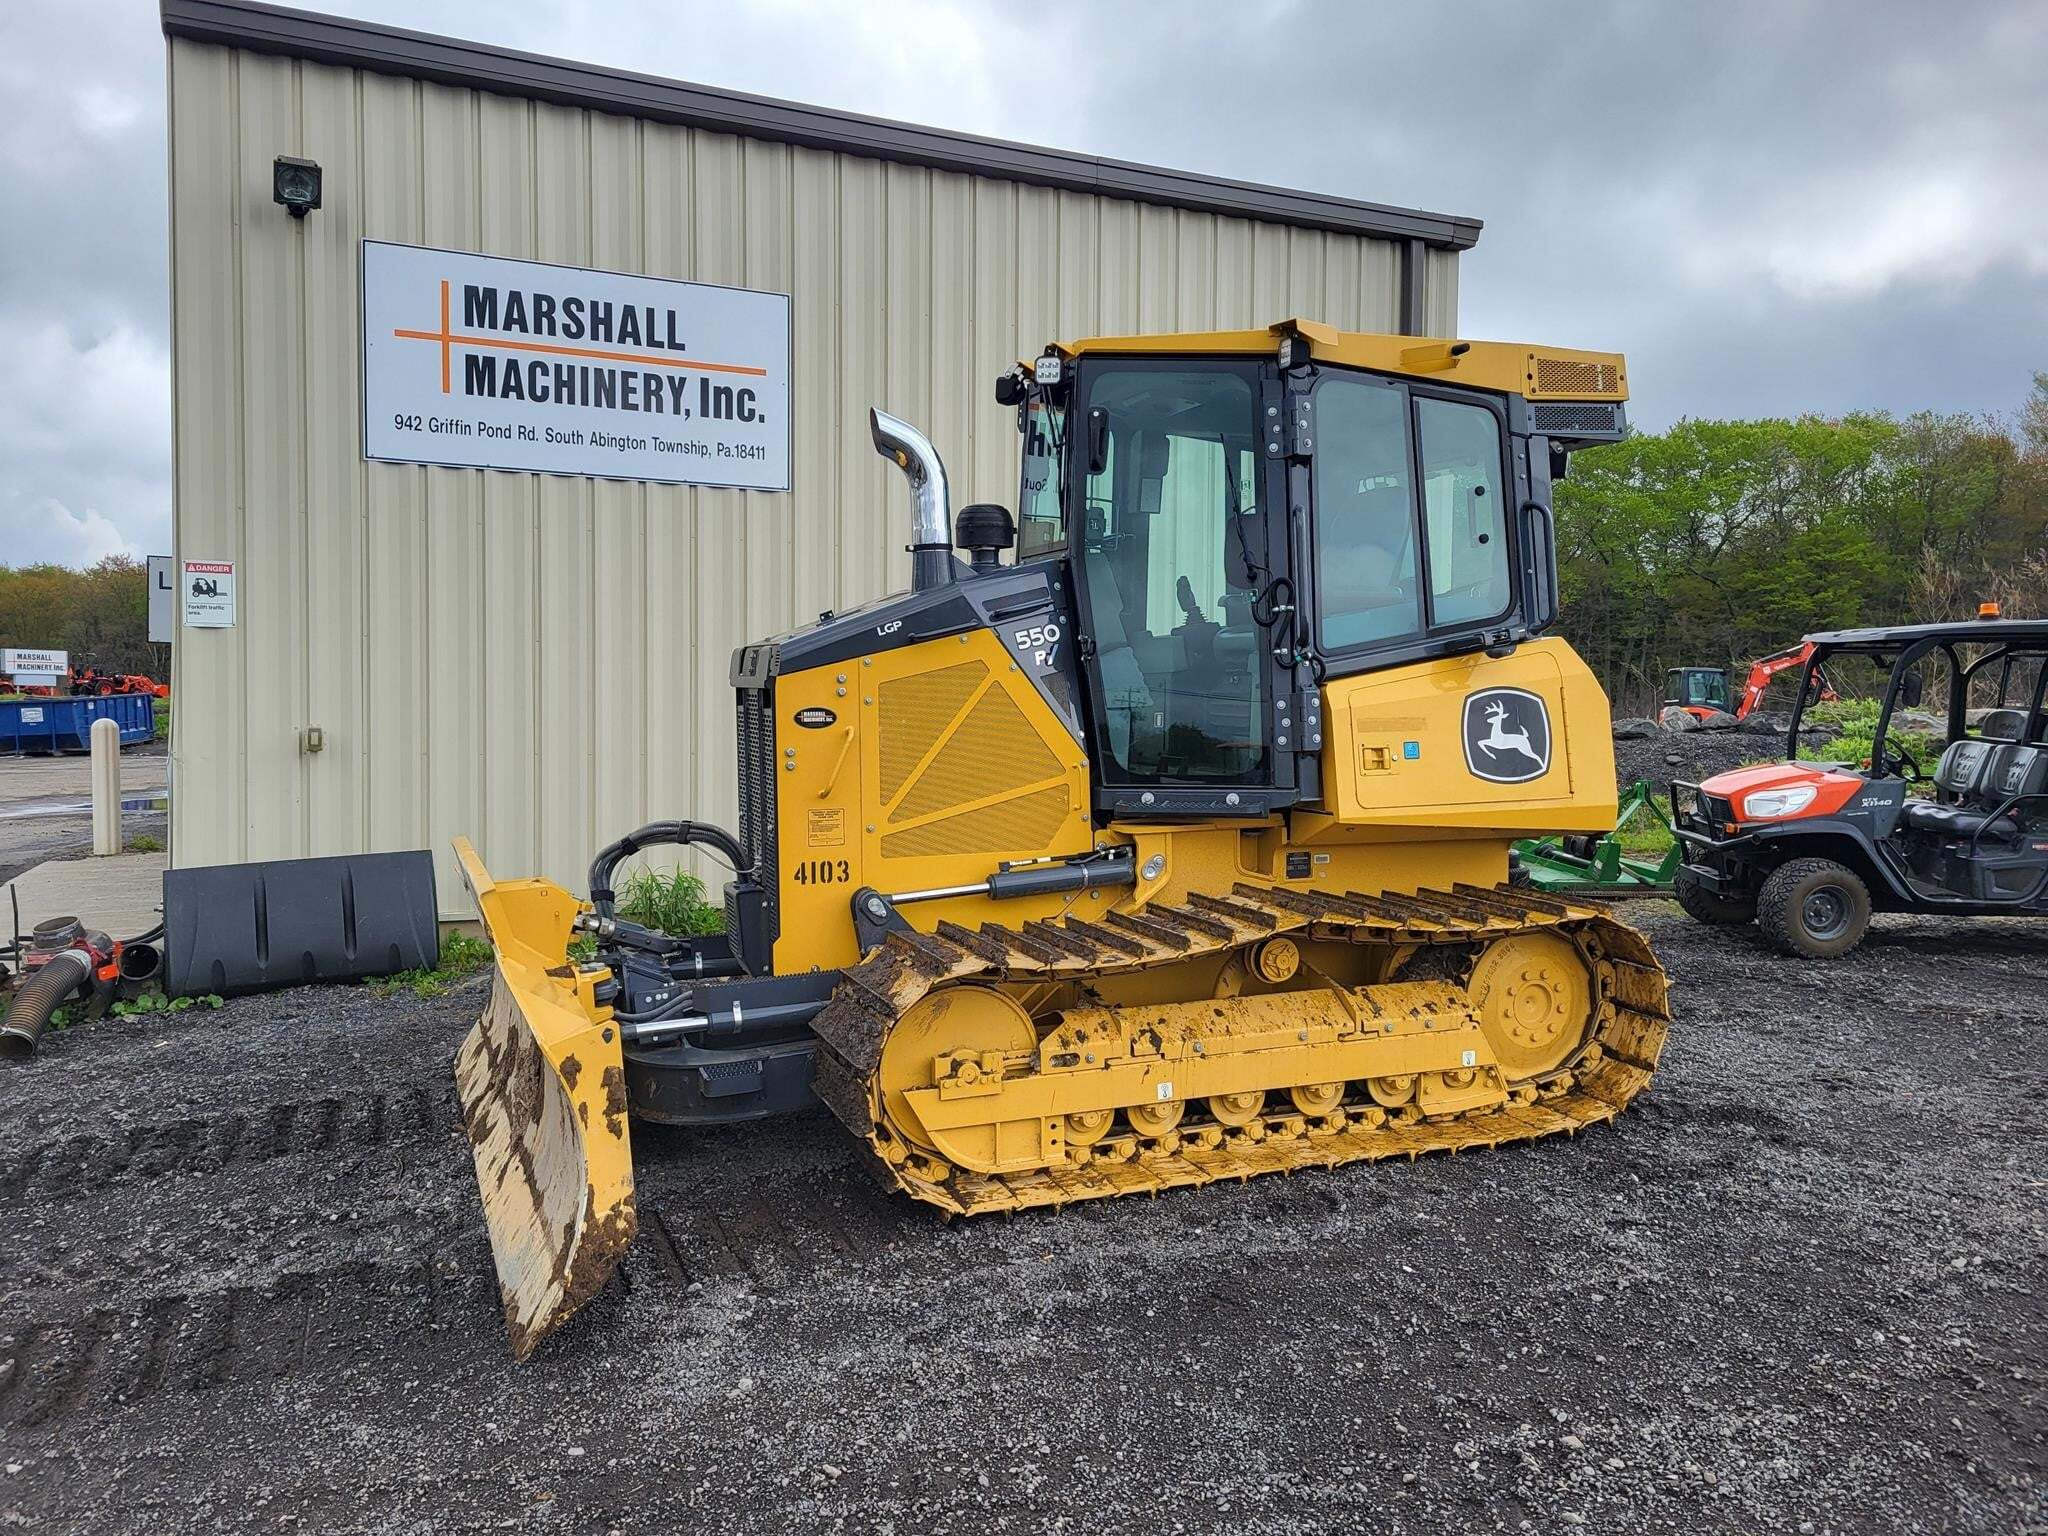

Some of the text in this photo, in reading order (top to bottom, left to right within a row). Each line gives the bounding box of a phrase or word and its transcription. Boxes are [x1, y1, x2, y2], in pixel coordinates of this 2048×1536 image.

[464, 284, 686, 351] MARSHALL
[465, 354, 766, 424] MACHINERY, Inc.
[394, 414, 423, 432] 942
[428, 416, 472, 436] Griffin
[478, 421, 512, 440] Pond
[518, 425, 540, 442] Rd.
[545, 427, 584, 446] South
[589, 431, 647, 452] Abington
[651, 436, 712, 459] Township,
[196, 564, 230, 573] DANGER
[876, 620, 902, 637] LGP
[1014, 624, 1060, 650] 550
[17, 653, 53, 661] MARSHALL
[794, 860, 850, 885] 4103
